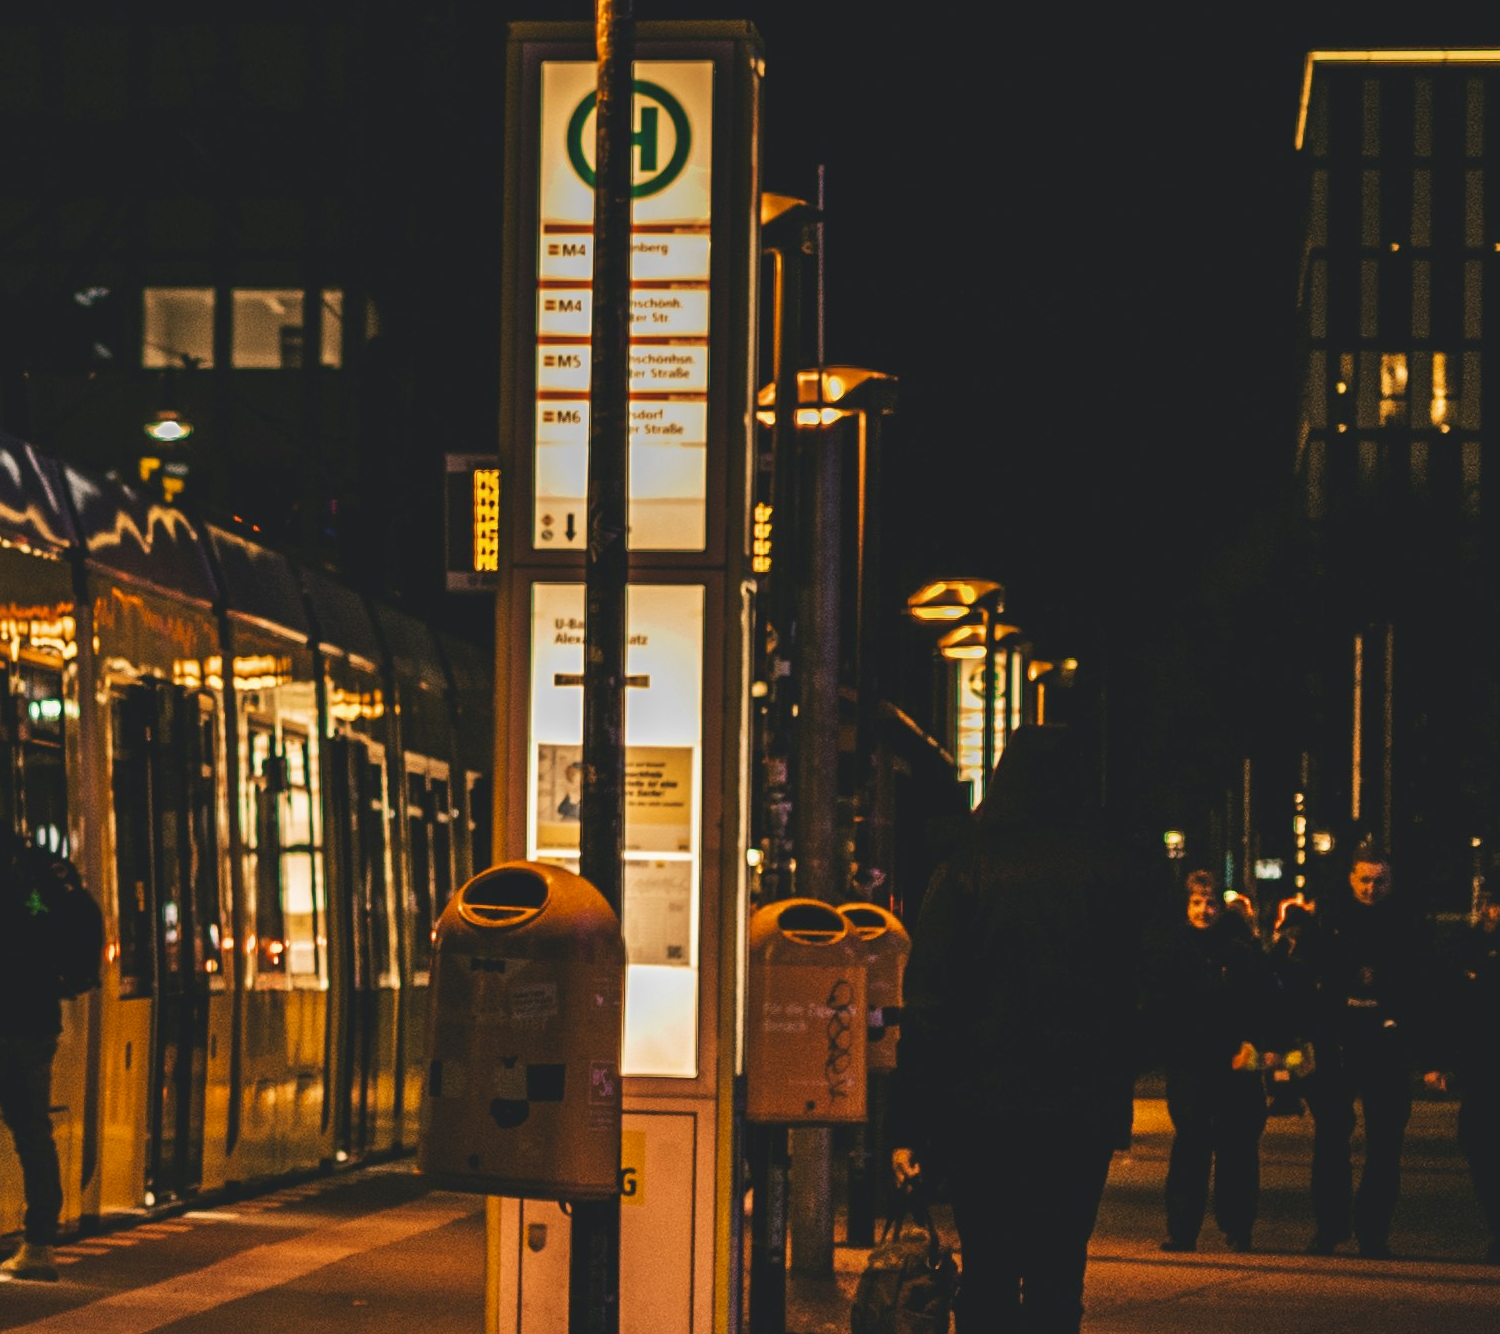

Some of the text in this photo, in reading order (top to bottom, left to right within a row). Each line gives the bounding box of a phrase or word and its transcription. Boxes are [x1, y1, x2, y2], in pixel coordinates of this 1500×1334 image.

[562, 244, 586, 256] M4
[558, 300, 582, 312] M4
[557, 355, 581, 367] M5
[650, 368, 690, 379] Straße
[557, 411, 581, 423] M6
[644, 423, 684, 435] Straße
